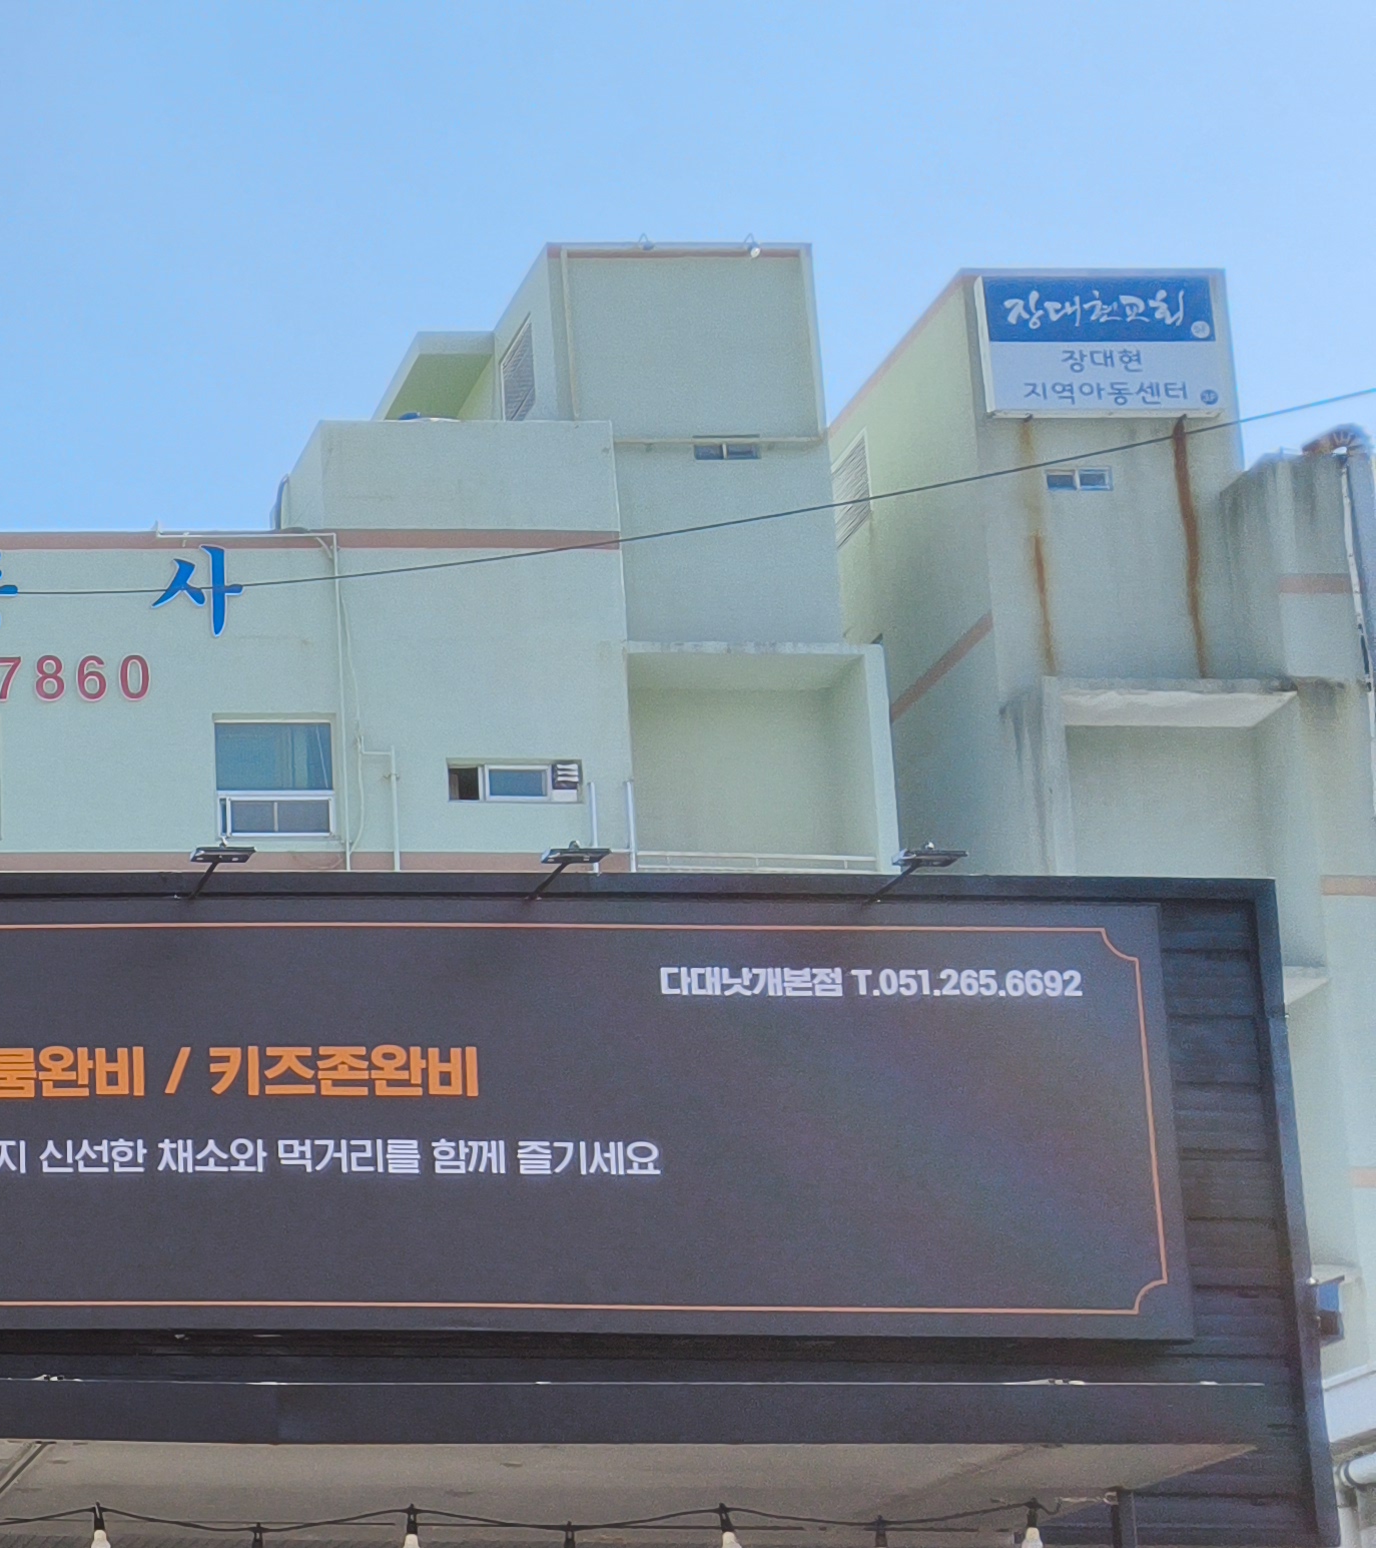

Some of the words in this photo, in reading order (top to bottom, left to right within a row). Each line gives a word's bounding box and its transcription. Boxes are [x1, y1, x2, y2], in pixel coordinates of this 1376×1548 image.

[1004, 289, 1185, 330] 장대현교회
[1061, 349, 1143, 374] 장대현
[1023, 381, 1189, 406] 지역아동센터
[660, 966, 844, 998] 다대낫개본점
[851, 968, 1084, 998] T.051.265.6692
[210, 1046, 478, 1098] 키즈존완비
[38, 1137, 148, 1174] 신선한
[156, 1137, 269, 1174] 채소와
[276, 1137, 423, 1174] 먹거리를
[430, 1137, 508, 1174] 함께
[515, 1139, 663, 1176] 즐기세요
